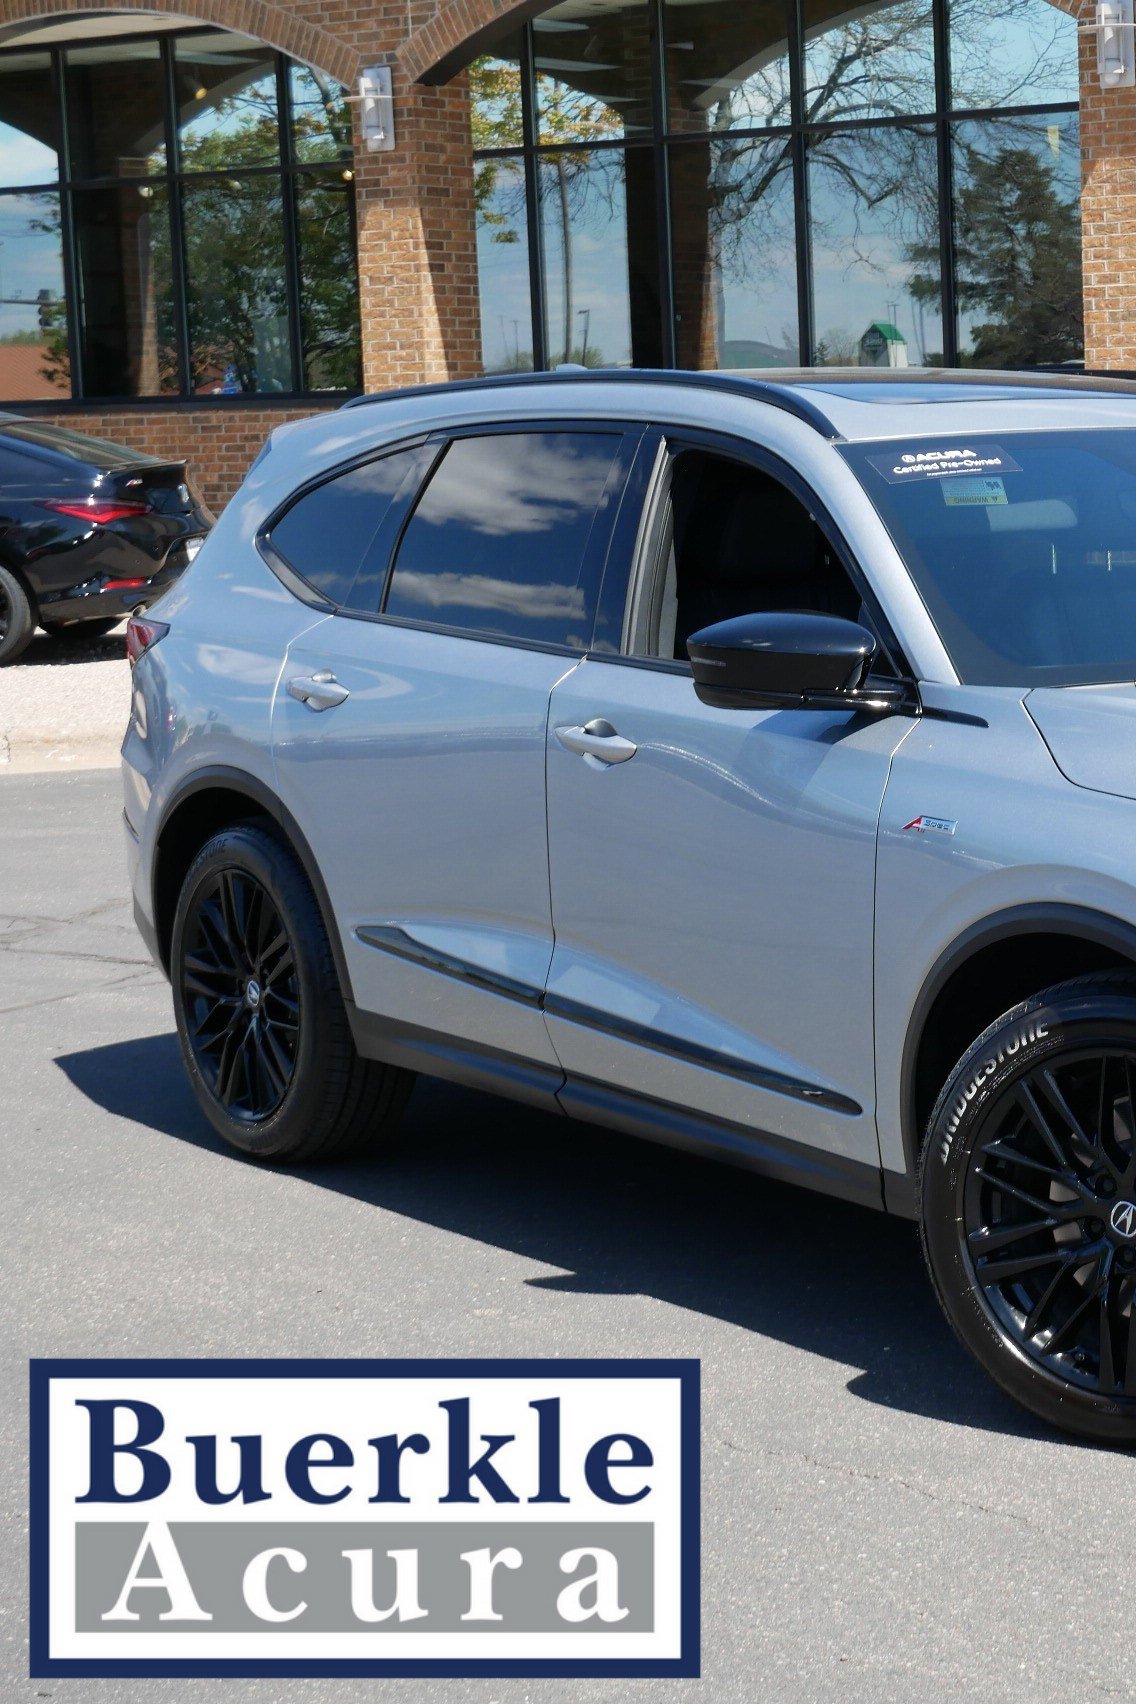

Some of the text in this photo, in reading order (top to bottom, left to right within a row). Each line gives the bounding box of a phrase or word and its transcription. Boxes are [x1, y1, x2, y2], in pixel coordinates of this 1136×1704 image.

[917, 449, 977, 462] ACURA
[892, 462, 940, 474] Certified
[940, 457, 1002, 468] Pre-Owned
[940, 1022, 1049, 1166] BRIDGESTONE
